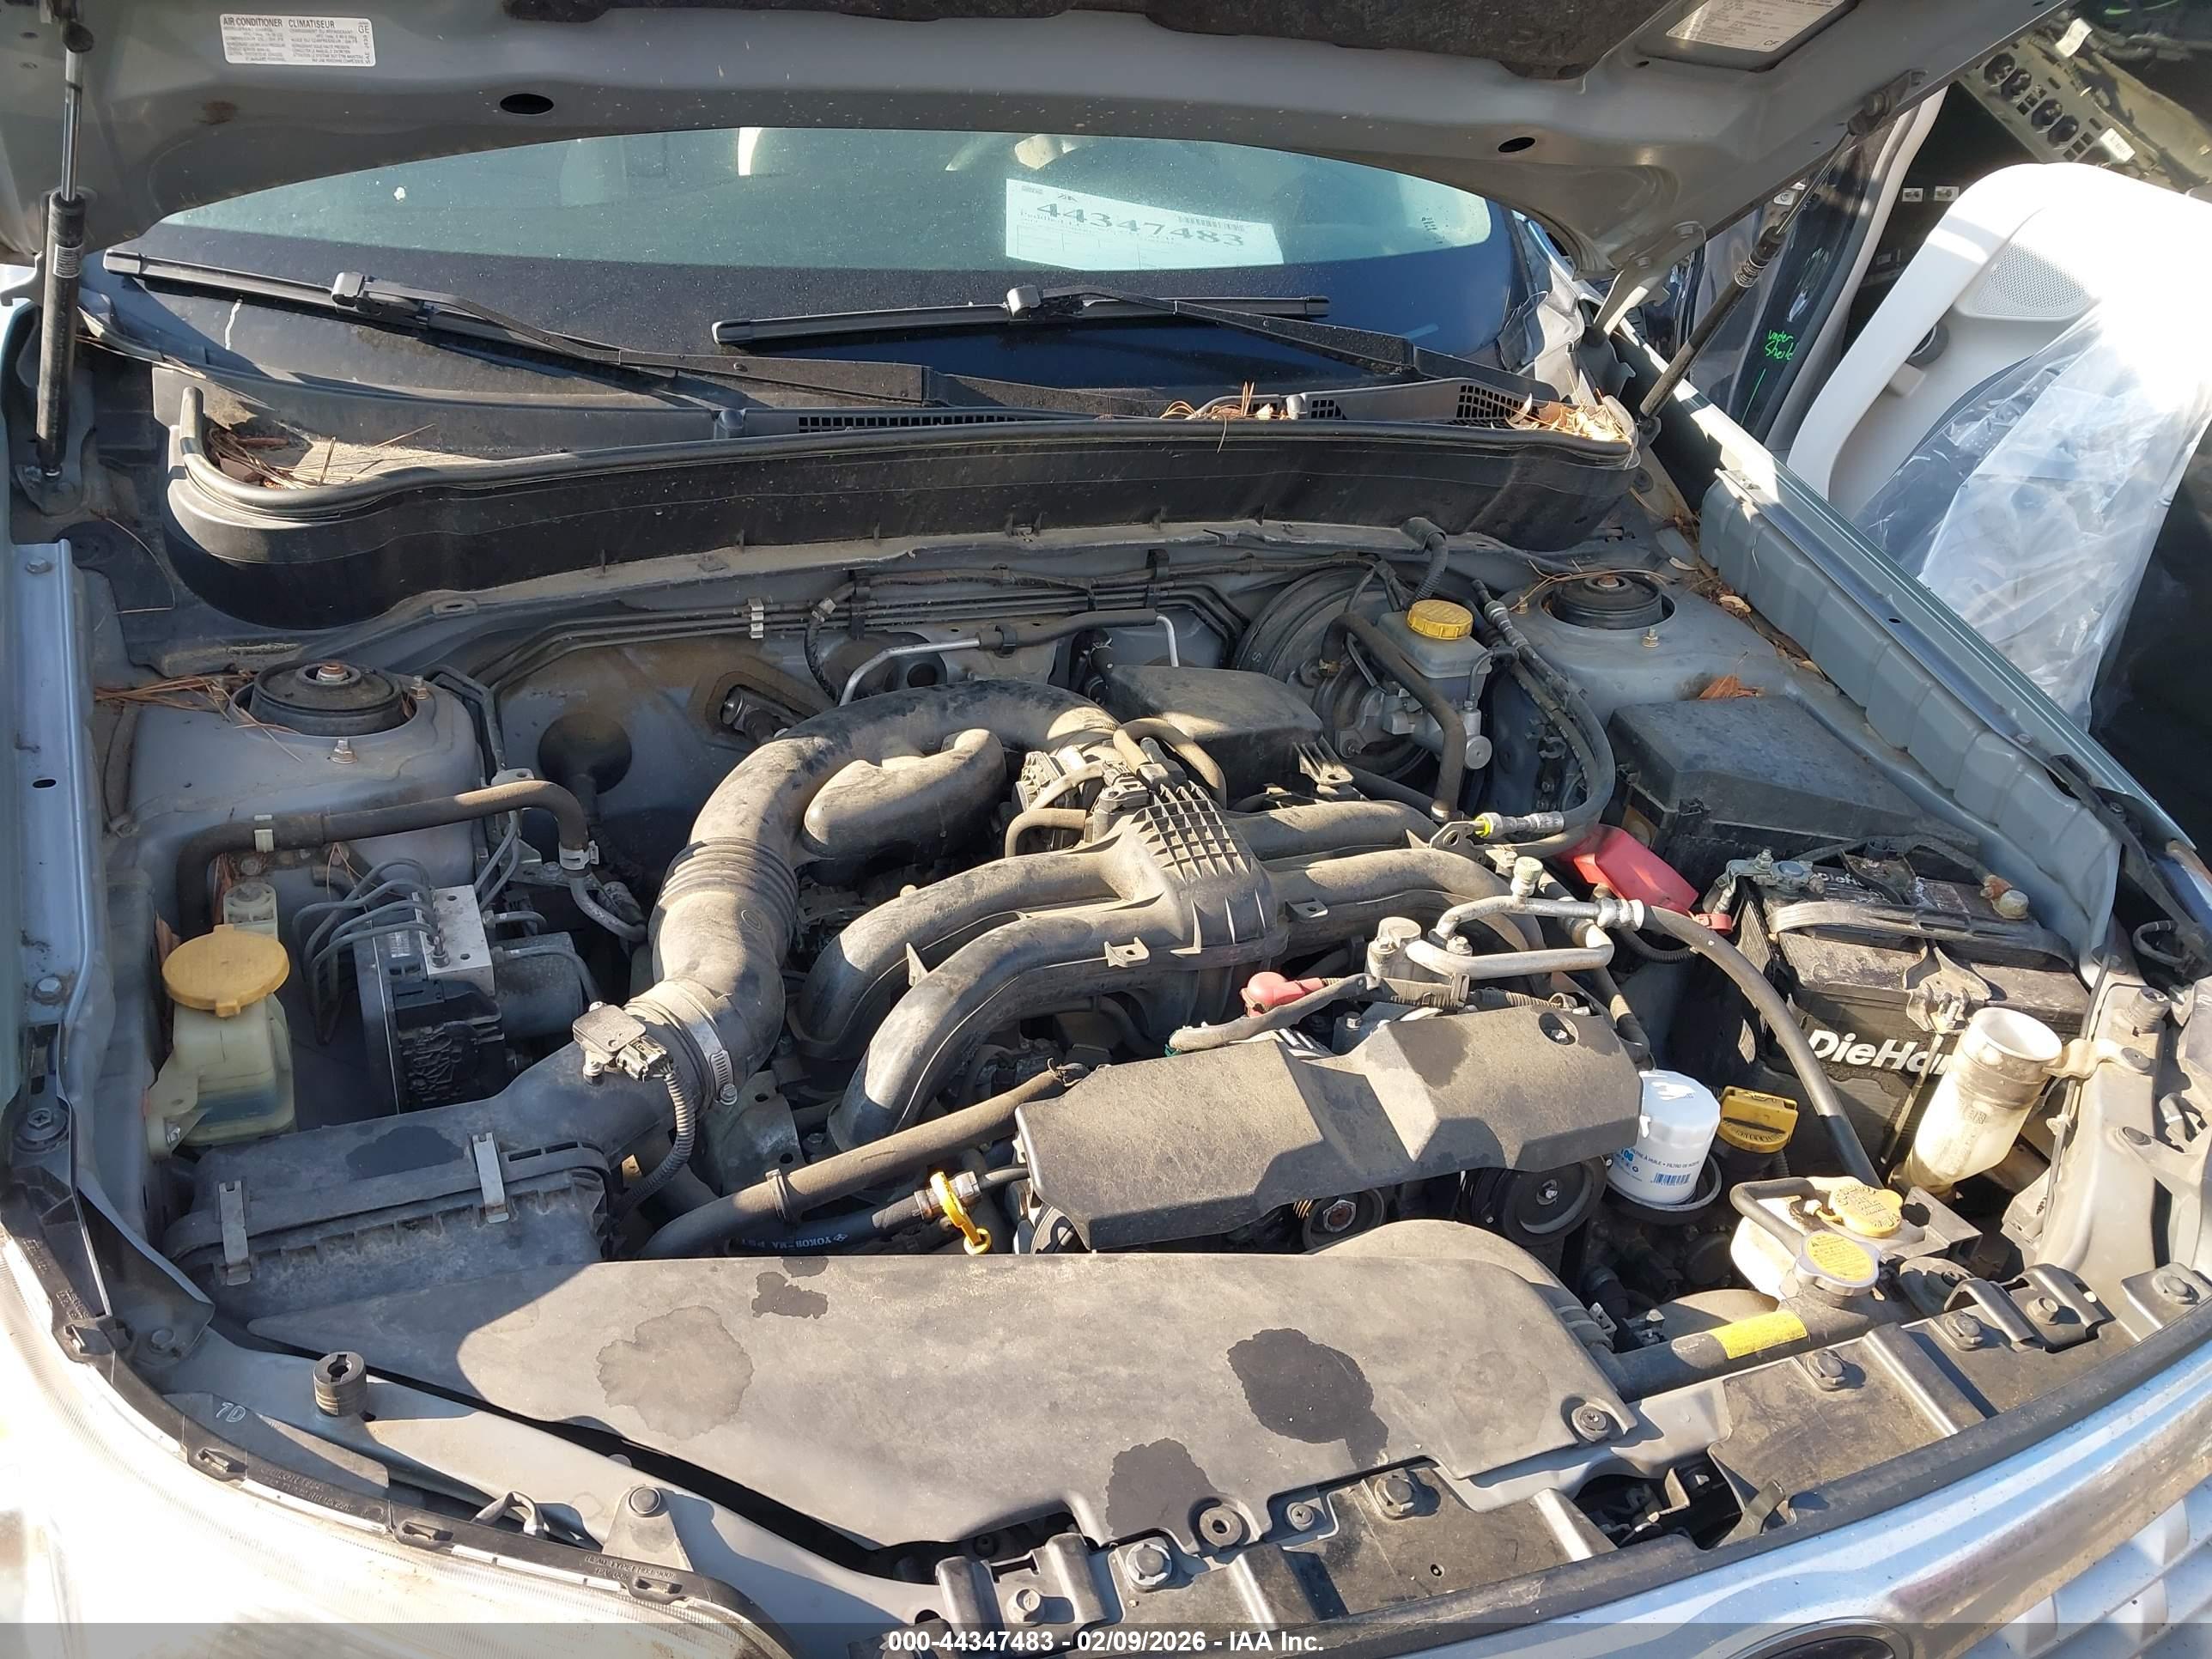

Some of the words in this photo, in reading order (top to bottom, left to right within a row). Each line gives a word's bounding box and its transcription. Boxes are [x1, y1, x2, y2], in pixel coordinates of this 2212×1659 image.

[223, 16, 234, 27] AIR
[236, 17, 283, 27] CONDITIONER
[289, 19, 336, 28] CLIMATISEUR
[358, 25, 370, 33] GE
[1036, 203, 1244, 246] 44347483
